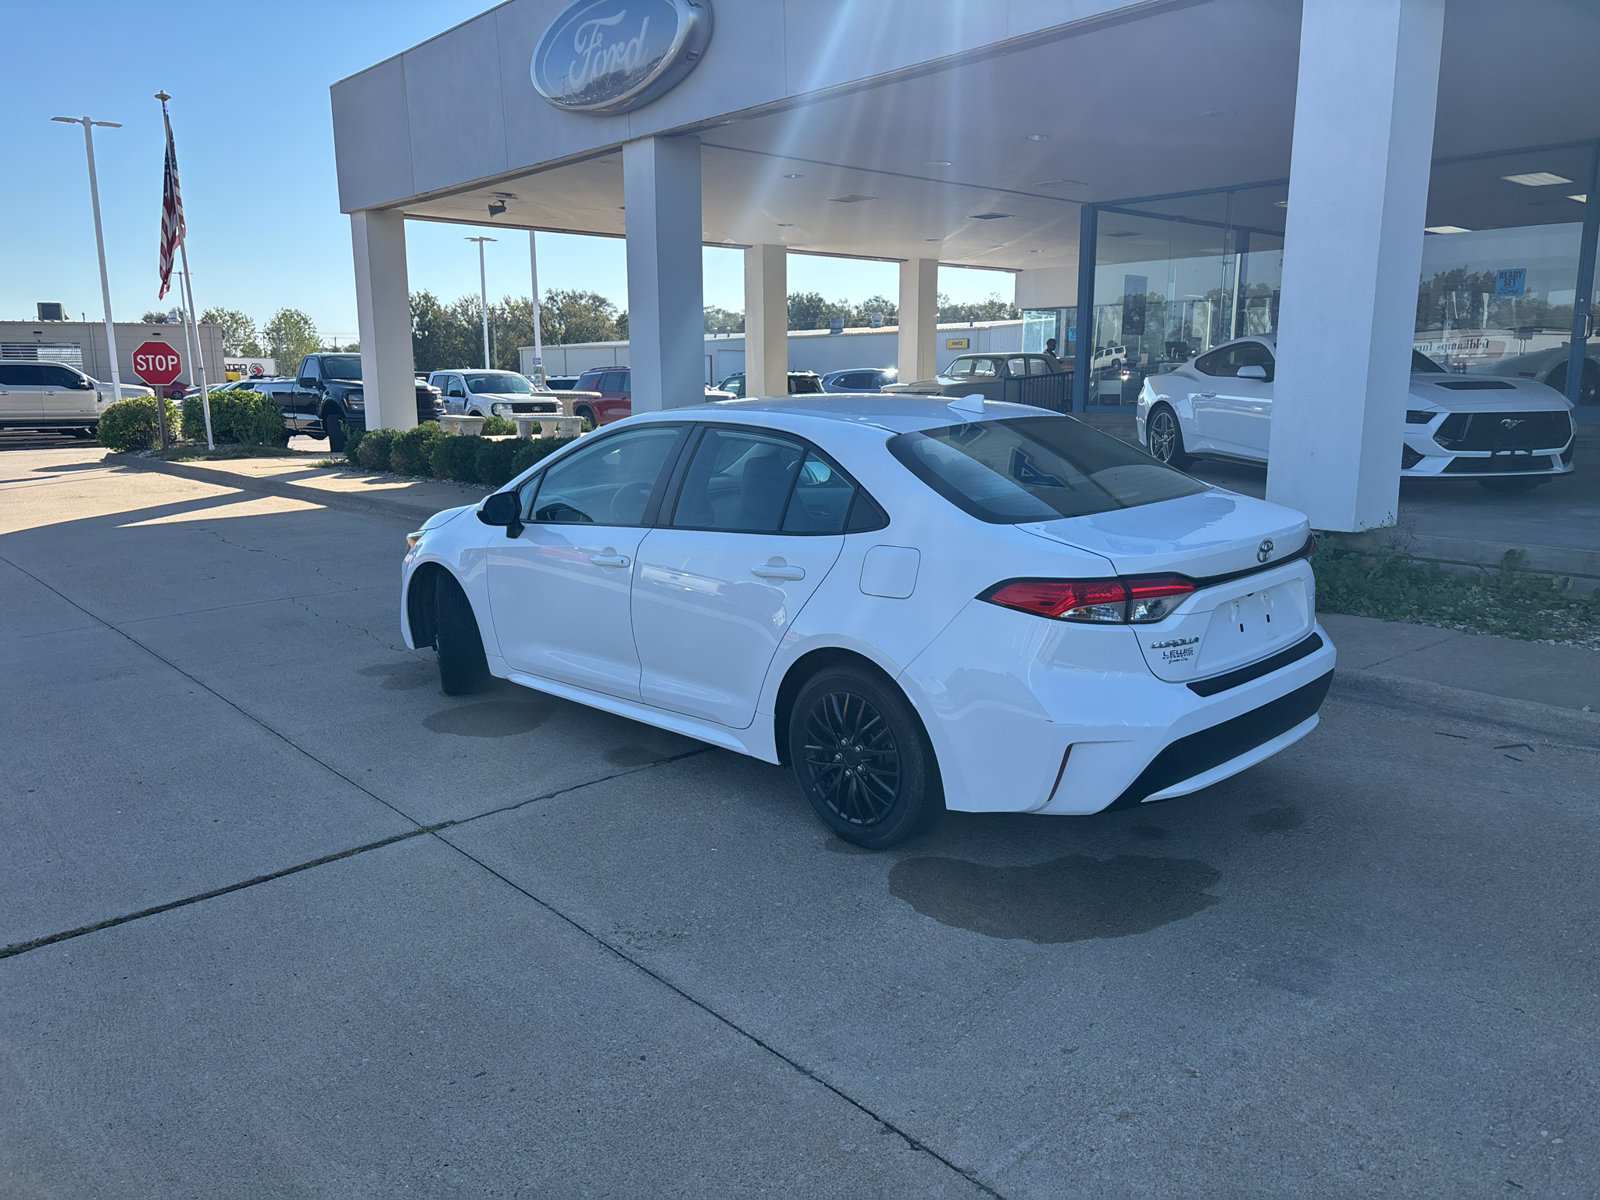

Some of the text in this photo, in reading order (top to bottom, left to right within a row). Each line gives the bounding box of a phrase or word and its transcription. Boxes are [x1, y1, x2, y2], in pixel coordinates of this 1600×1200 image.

[568, 9, 651, 90] Ford
[136, 354, 178, 371] STOP
[1162, 647, 1194, 657] LEWIS
